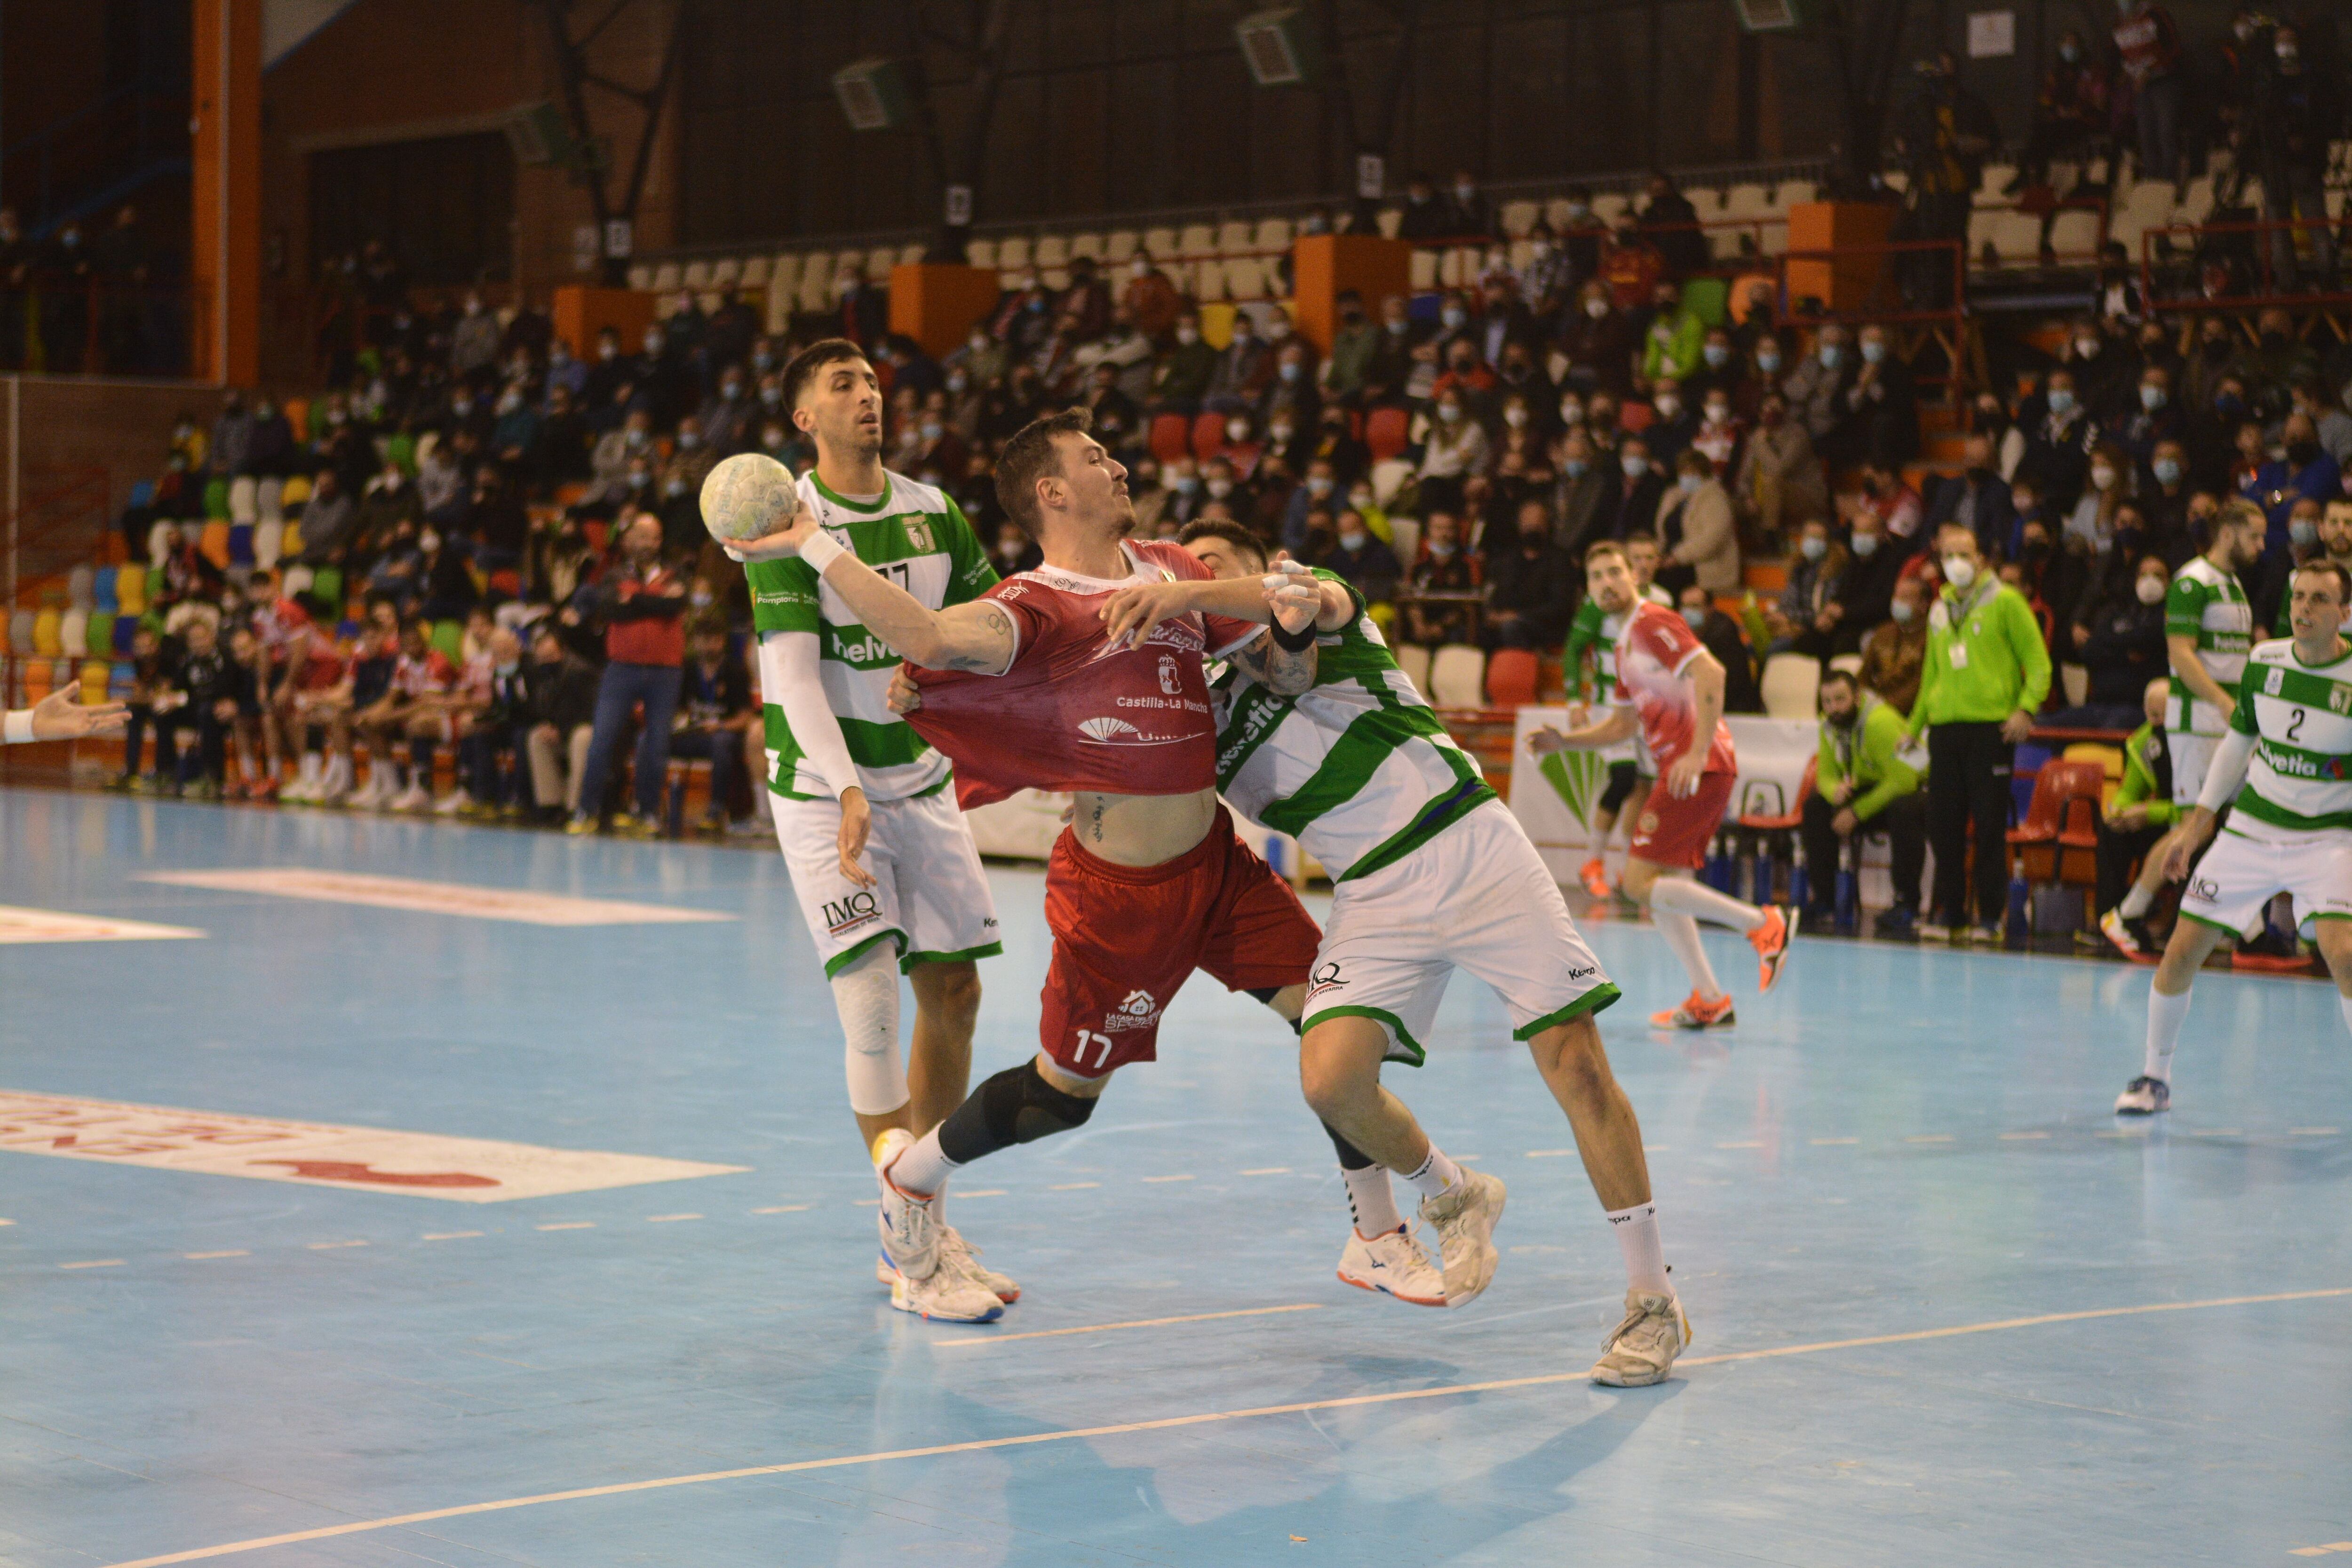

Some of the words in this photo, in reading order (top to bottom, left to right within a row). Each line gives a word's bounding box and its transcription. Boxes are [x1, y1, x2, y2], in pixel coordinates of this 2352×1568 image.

[758, 597, 799, 605] Pamplona
[1117, 697, 1181, 709] Castilla-La
[1184, 699, 1208, 714] Mancha
[2287, 709, 2304, 742] 2
[821, 892, 883, 928] IMQ
[1319, 986, 1343, 995] NAVARRA
[1073, 1029, 1112, 1069] 17
